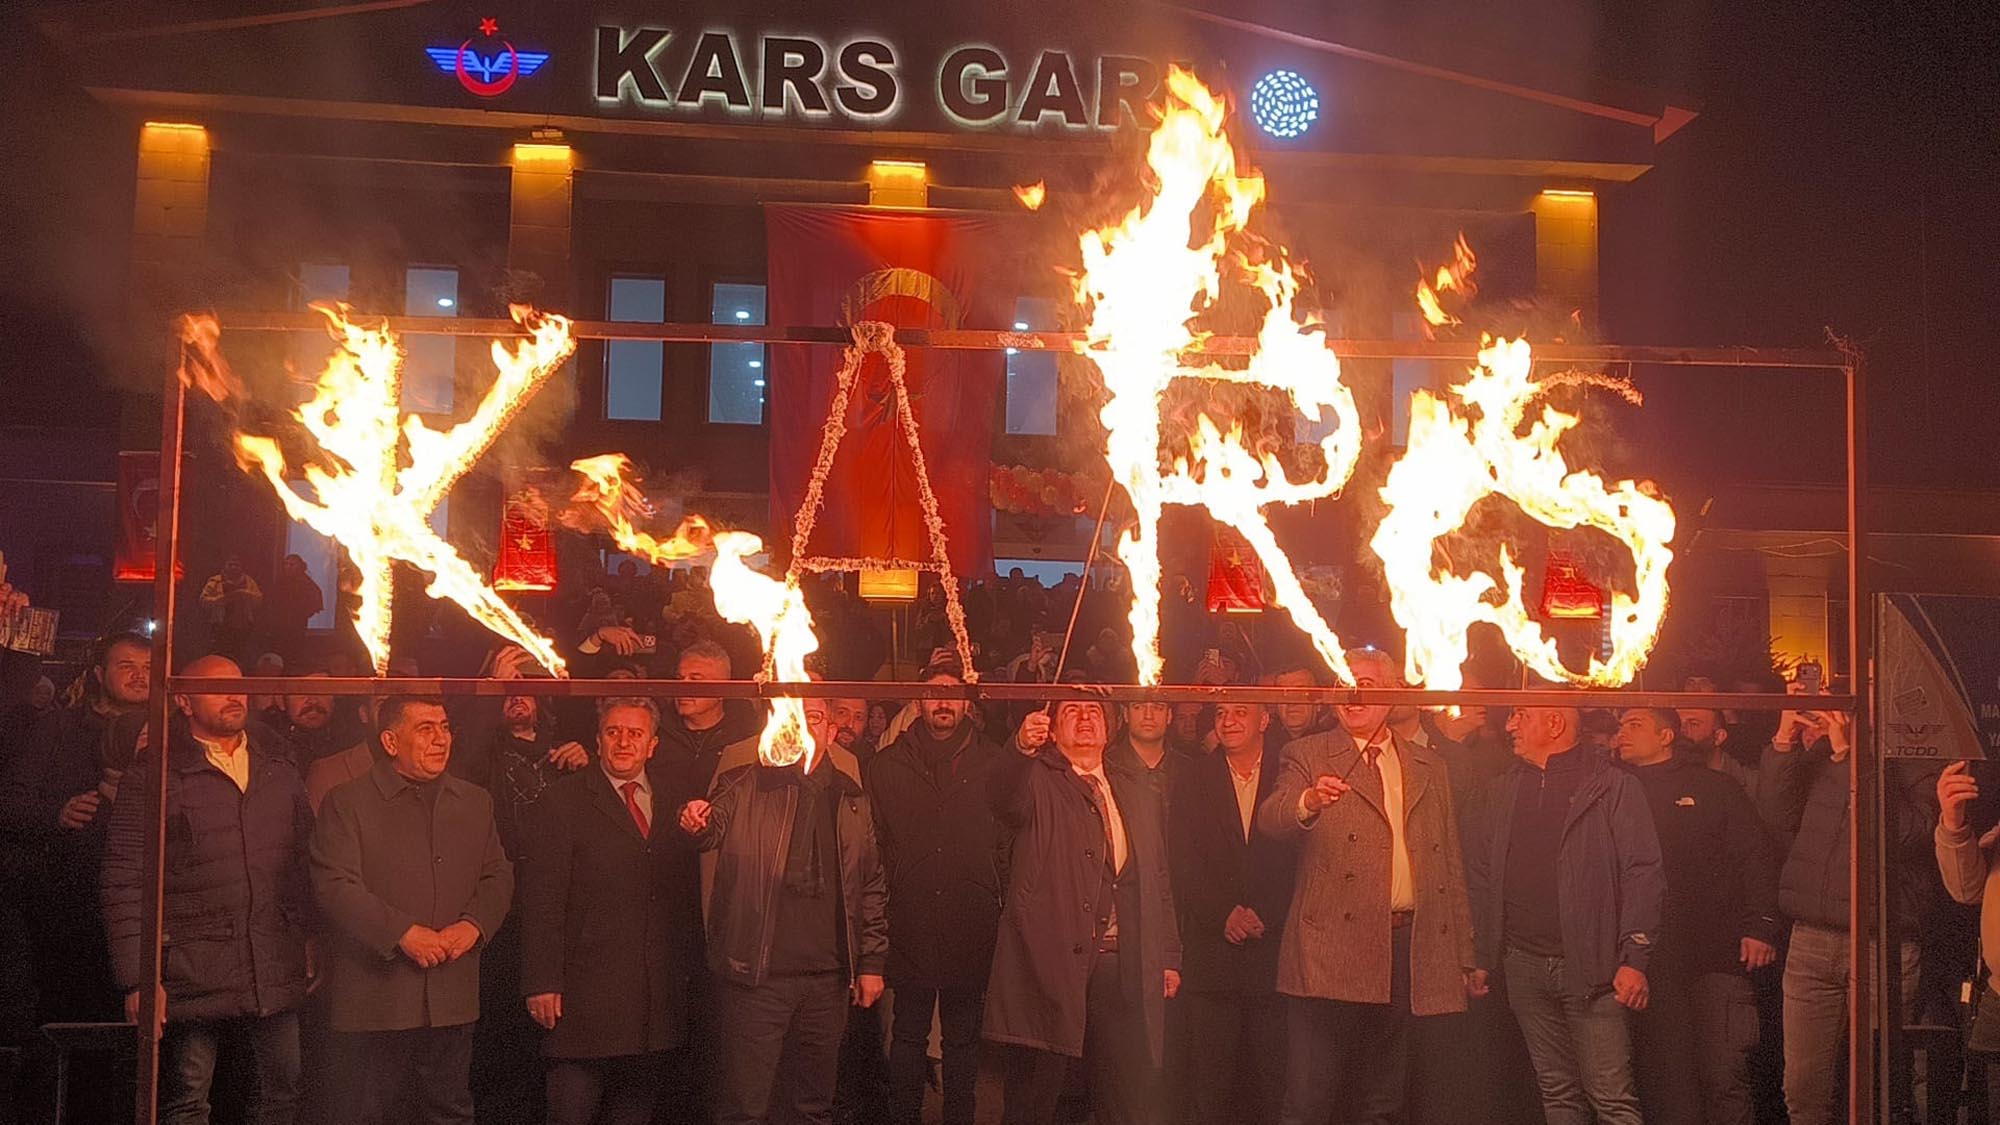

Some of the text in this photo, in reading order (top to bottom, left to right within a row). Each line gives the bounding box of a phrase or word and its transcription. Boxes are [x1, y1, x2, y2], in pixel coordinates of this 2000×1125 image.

[596, 26, 1193, 132] KARS GAR
[1896, 745, 1938, 757] TCDD
